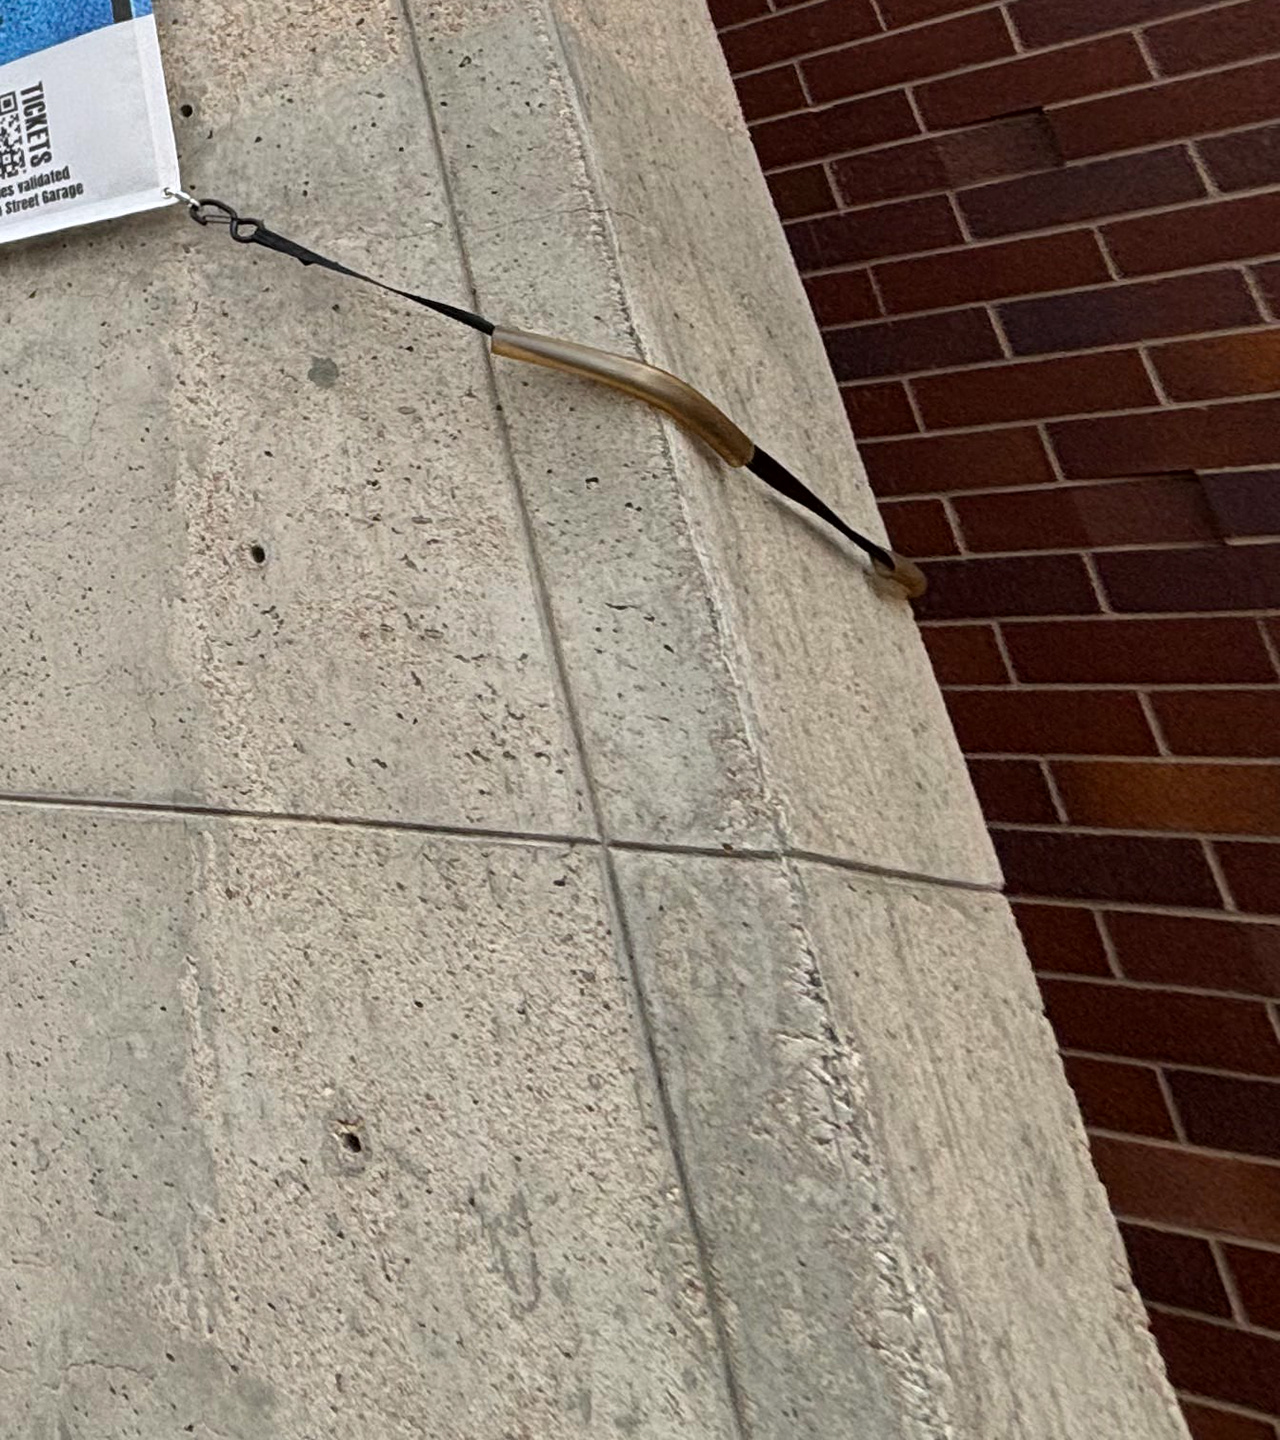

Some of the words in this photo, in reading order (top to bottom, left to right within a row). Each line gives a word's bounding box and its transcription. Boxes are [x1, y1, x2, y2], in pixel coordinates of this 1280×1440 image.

[20, 80, 53, 168] TICKETS
[17, 165, 71, 194] validated
[5, 193, 40, 215] Street
[41, 182, 85, 204] Garage
